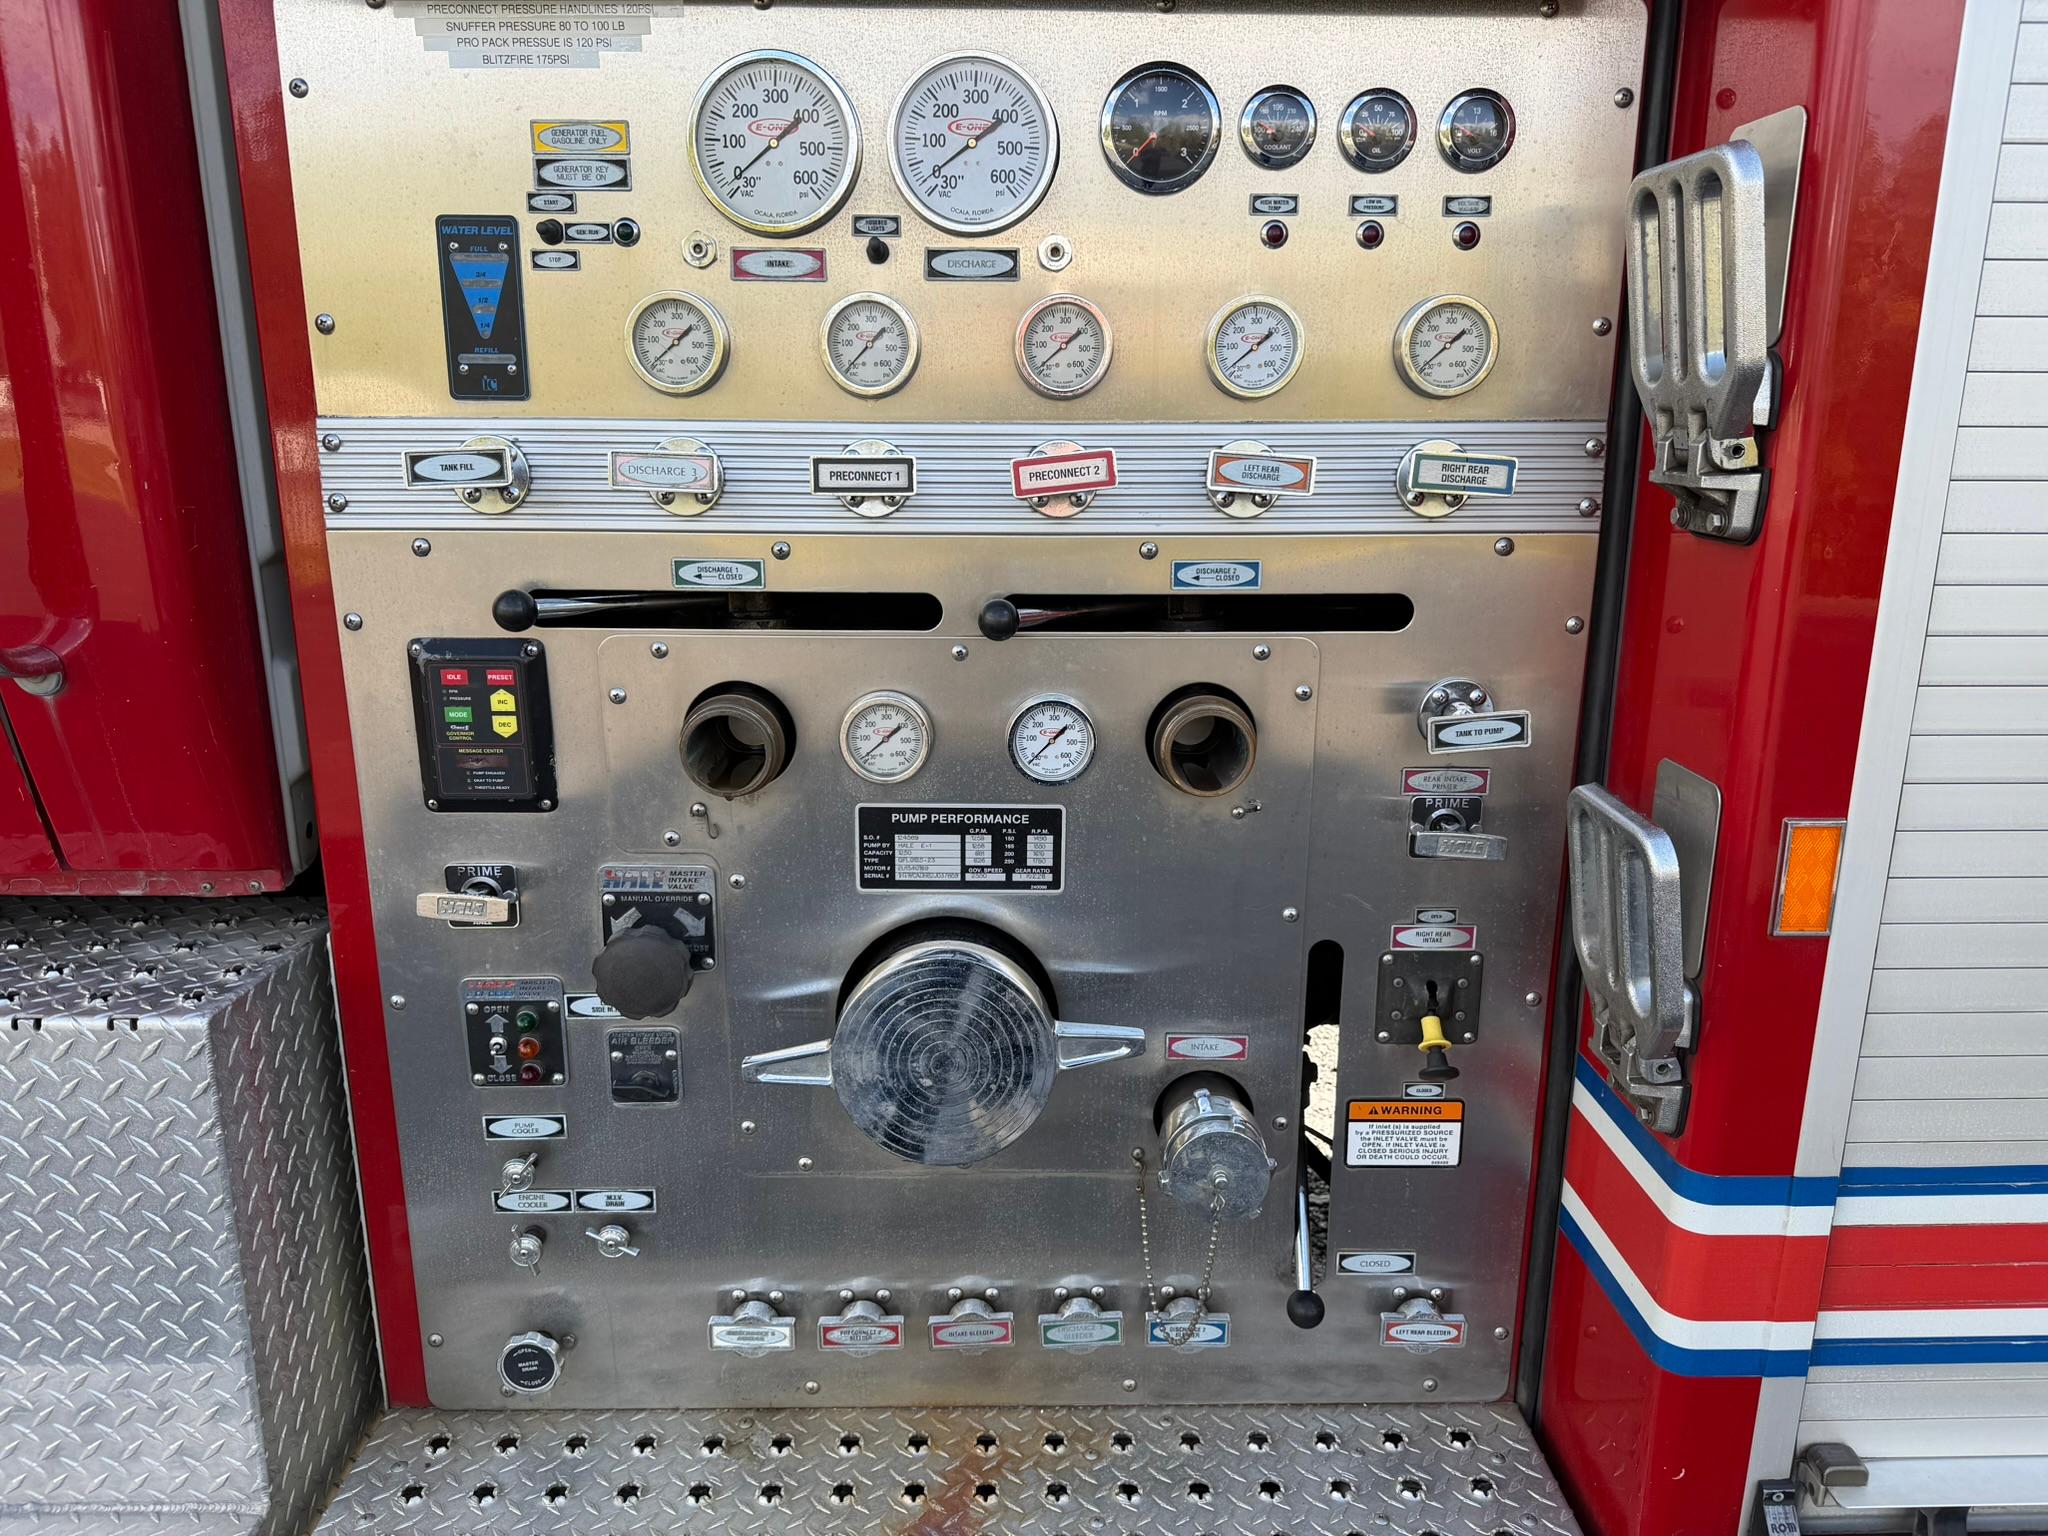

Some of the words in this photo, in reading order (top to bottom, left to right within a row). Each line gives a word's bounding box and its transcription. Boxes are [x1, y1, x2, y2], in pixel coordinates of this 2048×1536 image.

[427, 4, 498, 14] PRECONNECT
[501, 4, 557, 14] PRESSURE
[560, 4, 618, 14] HANDLINES
[622, 4, 654, 14] 120PSI
[446, 22, 496, 31] SNUFFER
[499, 22, 556, 31] PRESSURE
[559, 21, 571, 31] 80
[574, 21, 588, 31] TO
[592, 21, 609, 31] 100
[612, 21, 625, 31] LB
[457, 38, 480, 47] PRO
[482, 38, 510, 47] PACK
[512, 38, 561, 47] PRESSUE
[563, 38, 573, 47] IS
[577, 38, 593, 47] 120
[596, 38, 612, 47] PSI
[482, 55, 534, 64] BLITZFIRE
[536, 55, 570, 64] 175PSI
[762, 89, 789, 104] 300
[963, 89, 989, 104] 300
[1182, 99, 1188, 108] 2
[732, 103, 758, 118] 200
[933, 103, 959, 118] 200
[793, 109, 820, 123] 400
[992, 109, 1019, 124] 400
[551, 129, 588, 137] GENERATOR
[591, 129, 607, 137] FUEL
[551, 137, 586, 145] GASOLINE
[589, 137, 608, 145] ONLY
[722, 134, 746, 148] 100
[922, 133, 946, 148] 100
[800, 142, 825, 156] 500
[997, 141, 1023, 156] 500
[1181, 148, 1187, 156] 3
[734, 166, 743, 180] 0
[932, 164, 941, 179] 0
[990, 169, 1016, 184] 600
[793, 170, 819, 185] 600
[800, 190, 809, 199] psi
[938, 190, 952, 198] VAC
[995, 190, 1005, 198] psi
[776, 210, 798, 218] FLORIDA
[972, 207, 994, 216] FLORIDA
[441, 226, 479, 236] WATER
[481, 226, 513, 236] LEVEL
[766, 260, 790, 268] INTAKE
[947, 260, 996, 268] DISCHARGE
[440, 464, 458, 472] TANK
[460, 463, 475, 471] FILL
[628, 465, 686, 476] DISCHARGE
[691, 468, 697, 476] 3
[1243, 464, 1259, 473] LEFT
[1261, 465, 1280, 474] REAR
[1441, 463, 1466, 474] RIGHT
[1468, 465, 1489, 475] REAR
[829, 471, 892, 482] PRECONNECT
[895, 471, 900, 481] 1
[1029, 467, 1091, 482] PRECONNECT
[1093, 465, 1100, 476] 2
[1241, 472, 1281, 482] DISCHARGE
[1441, 474, 1487, 485] DISCHARGE
[1455, 729, 1472, 738] TANK
[1484, 727, 1504, 735] PUMP
[1425, 798, 1470, 809] PRIME
[892, 814, 928, 824] PUMP
[931, 814, 1029, 824] PERFORMANCE
[457, 866, 502, 876] PRIME
[483, 1005, 509, 1013] OPEN
[612, 1037, 627, 1045] AIR
[630, 1037, 674, 1045] BLEEDER
[487, 1074, 517, 1082] CLOSE
[1381, 1106, 1442, 1115] WARNING
[1770, 1523, 1797, 1533] ROM
